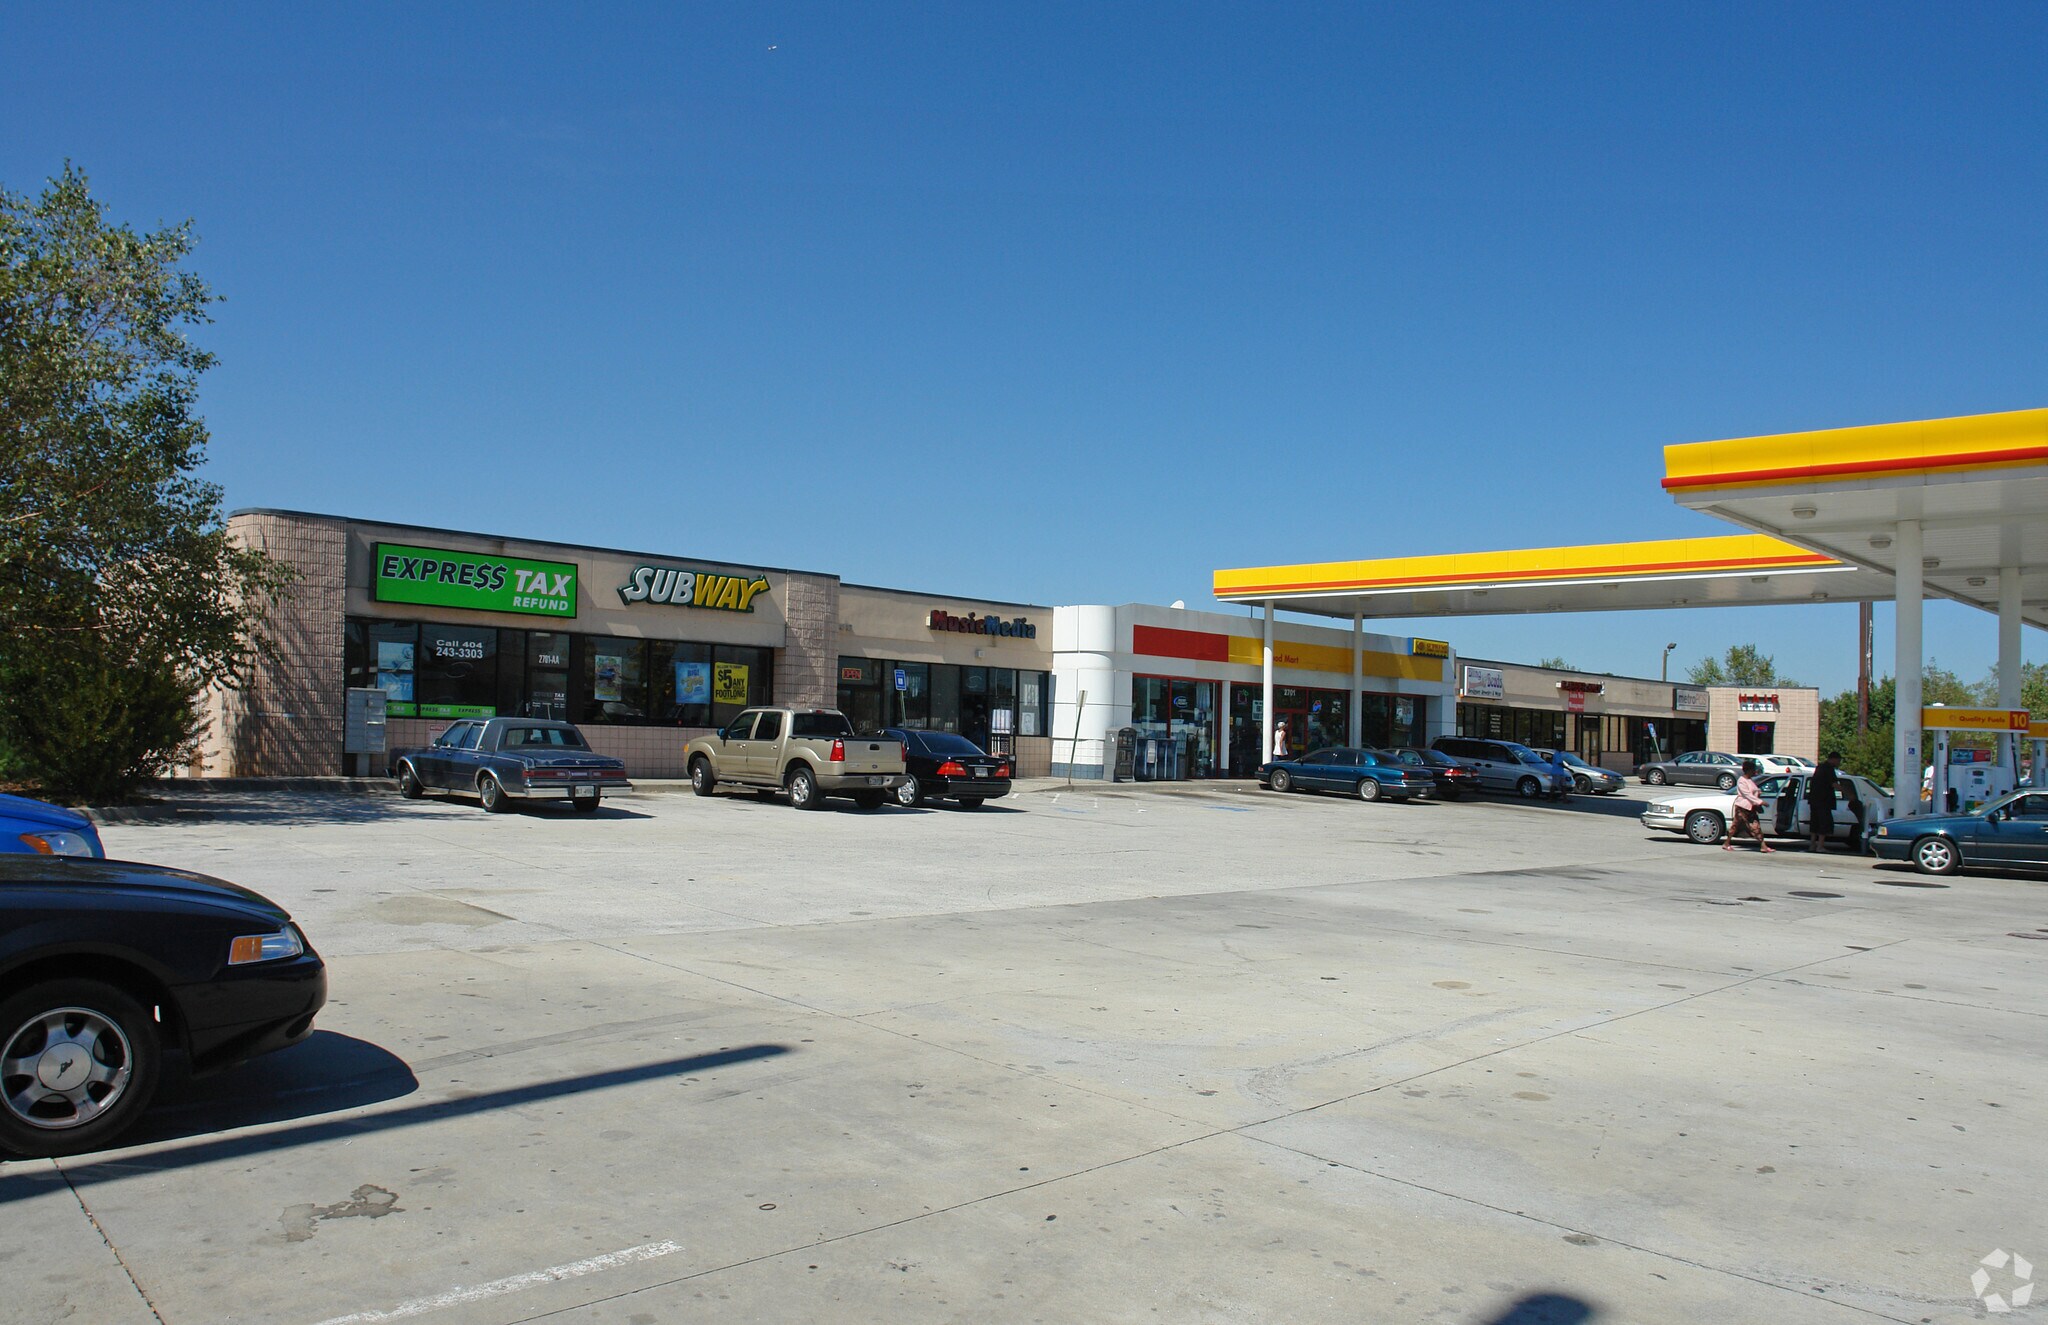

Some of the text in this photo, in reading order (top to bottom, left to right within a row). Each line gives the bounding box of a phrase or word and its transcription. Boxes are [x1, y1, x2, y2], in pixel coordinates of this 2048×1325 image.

[514, 569, 572, 597] TAX
[620, 566, 770, 611] SUBWAY
[513, 596, 569, 611] REFUND
[436, 639, 483, 649] Call 404
[436, 647, 483, 659] 243-3303
[1284, 656, 1299, 664] Mart
[718, 669, 732, 689] $5
[733, 679, 745, 687] ANY
[843, 669, 861, 679] OPEN
[716, 689, 746, 698] FOOTLONG
[1738, 693, 1779, 704] HAIR
[1960, 715, 1985, 723] Quality
[2012, 713, 2027, 728] 10
